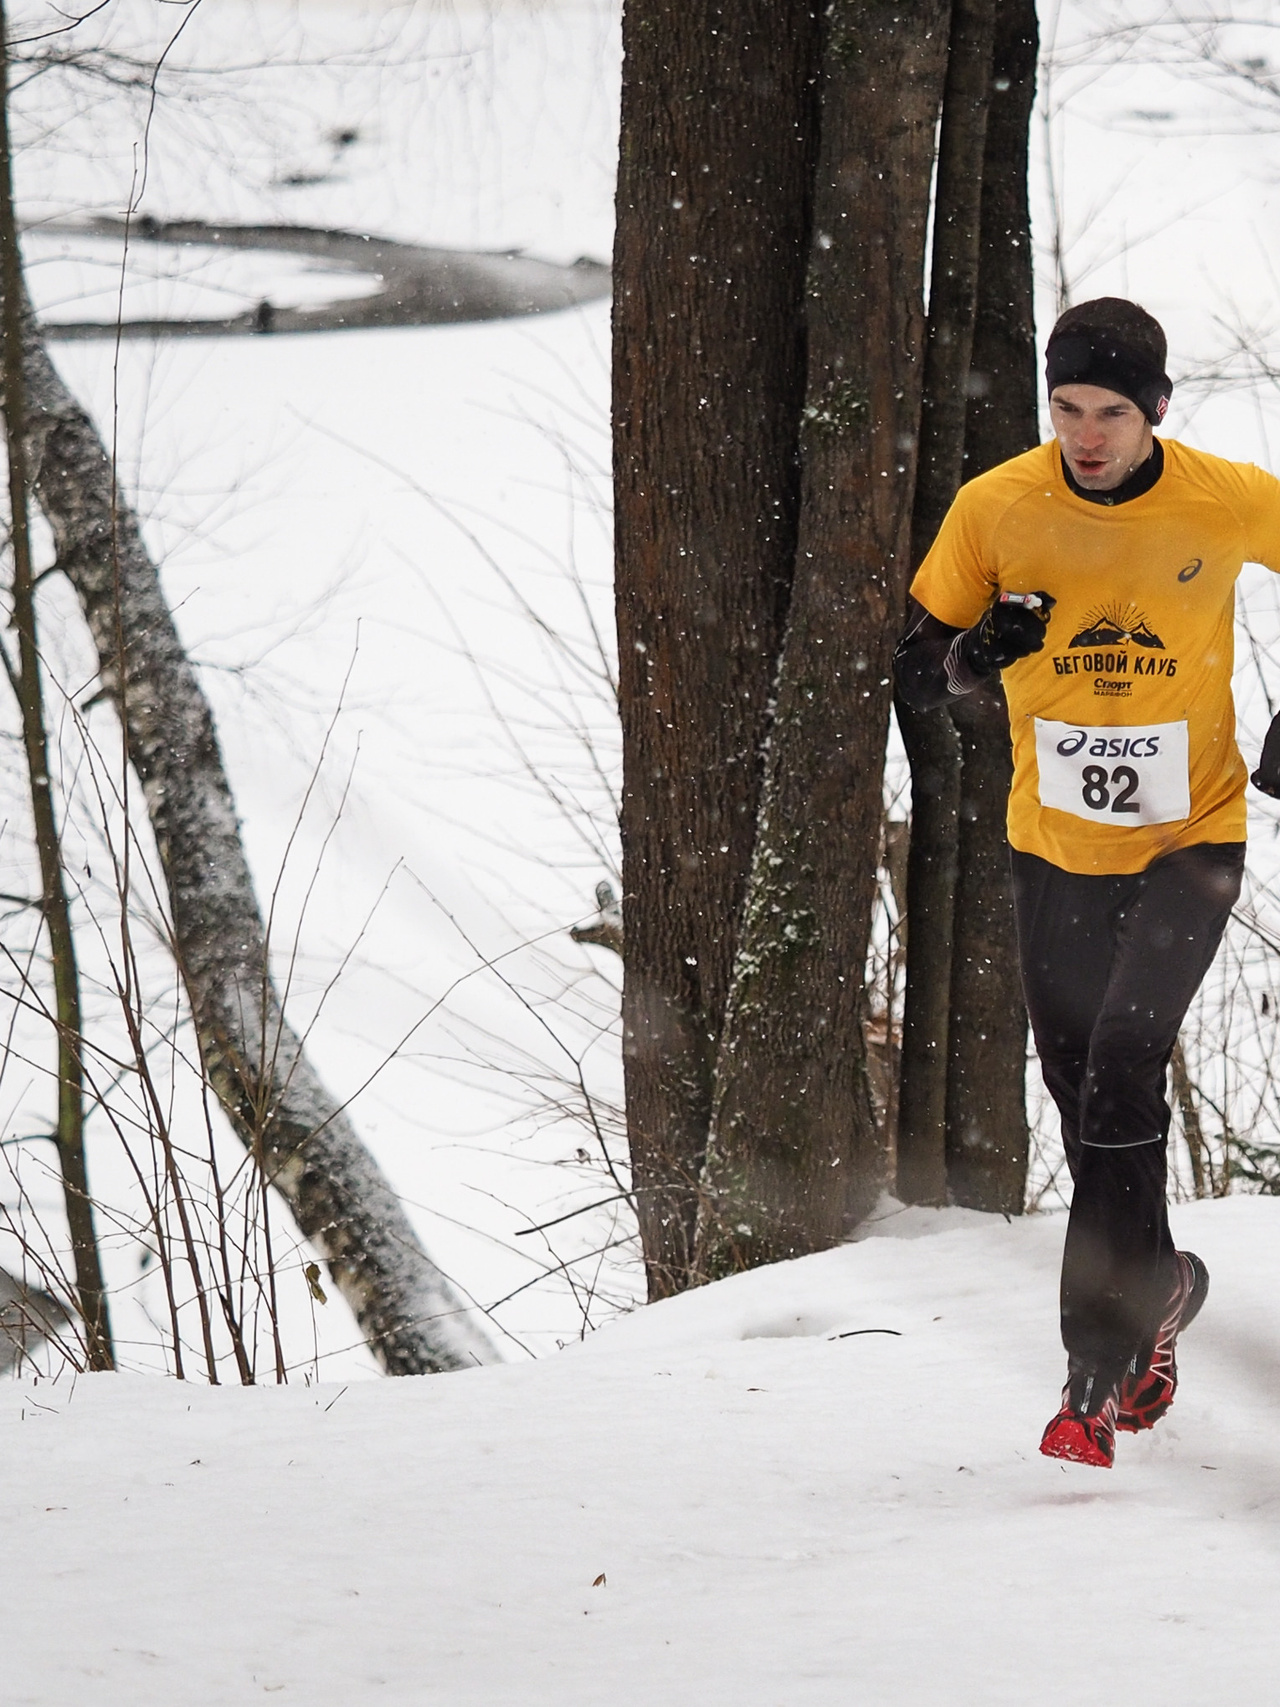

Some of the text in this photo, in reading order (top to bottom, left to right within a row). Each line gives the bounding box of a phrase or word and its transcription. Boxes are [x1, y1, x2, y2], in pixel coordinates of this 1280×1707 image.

[1052, 650, 1178, 677] БЕГОВОЙ КЛУБ
[1093, 678, 1133, 691] Спорт
[1082, 764, 1141, 813] 82
